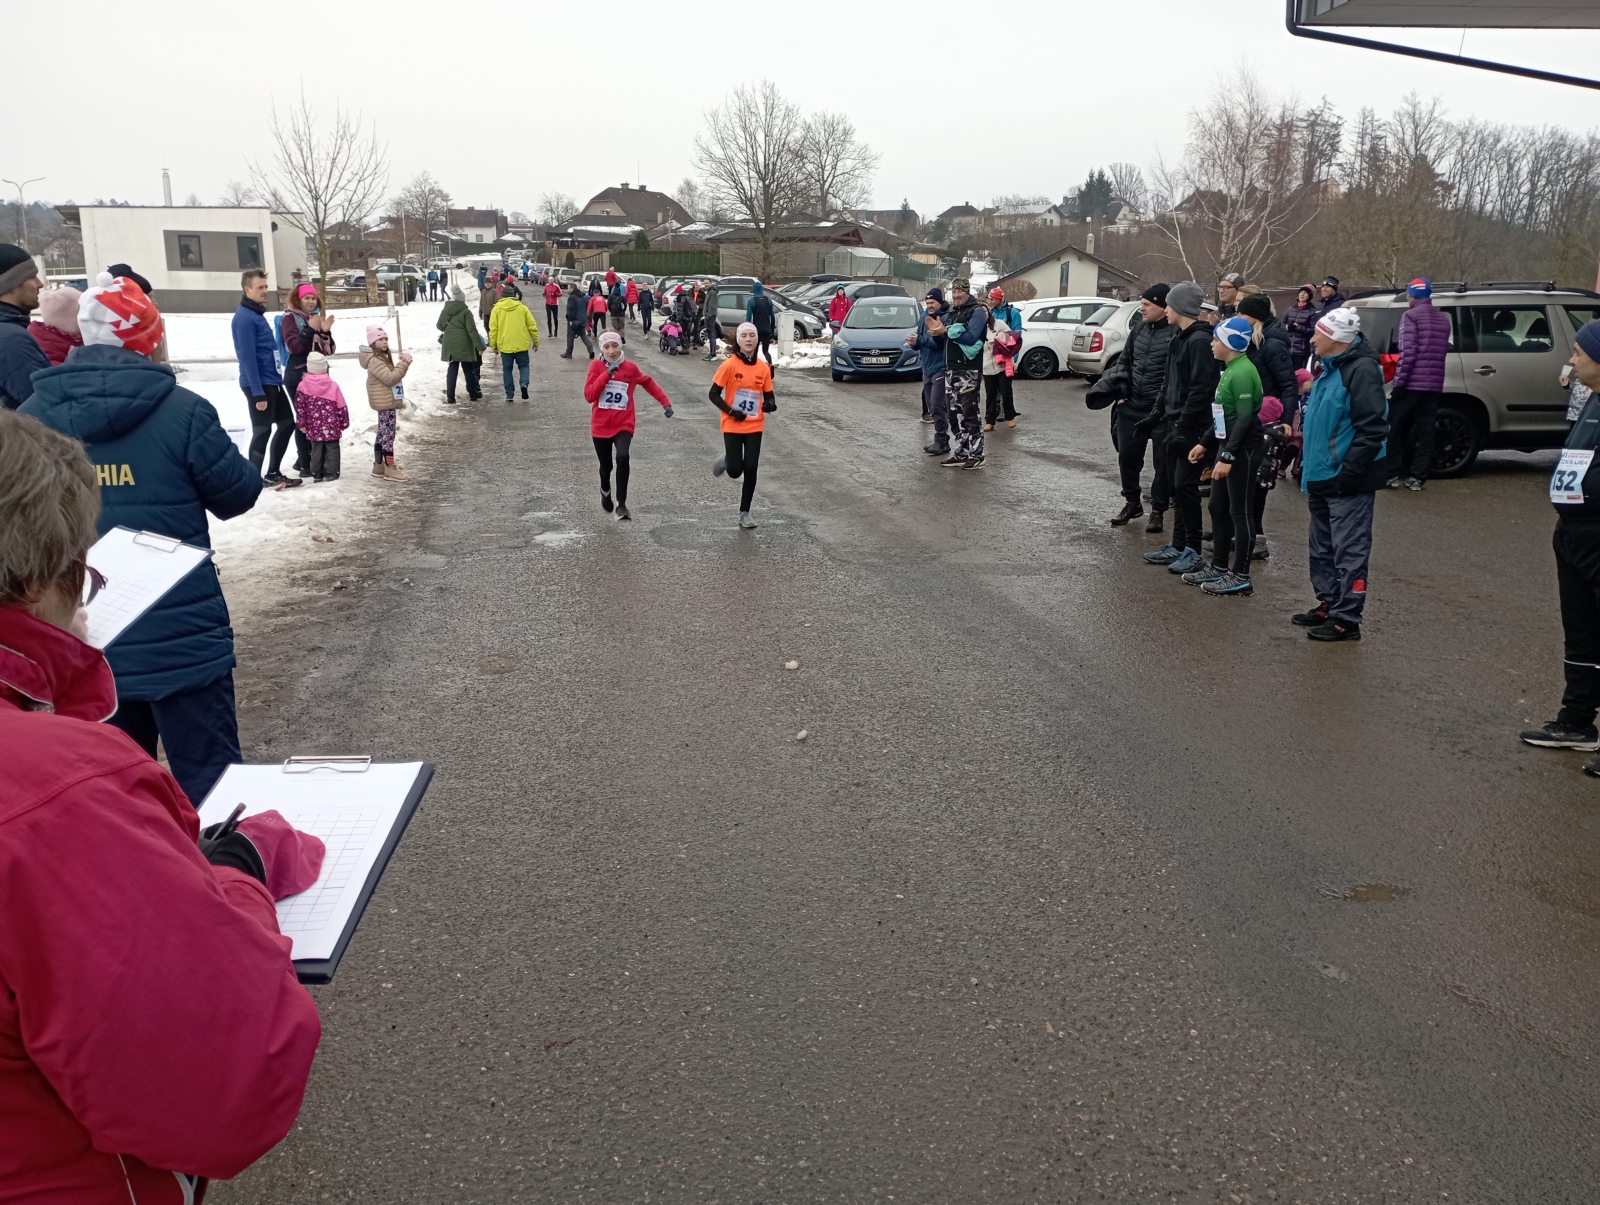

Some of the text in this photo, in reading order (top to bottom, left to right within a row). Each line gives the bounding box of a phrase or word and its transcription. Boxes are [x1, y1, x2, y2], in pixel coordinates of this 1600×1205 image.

[605, 391, 622, 403] 29
[738, 399, 754, 412] 43
[95, 464, 136, 486] HIA
